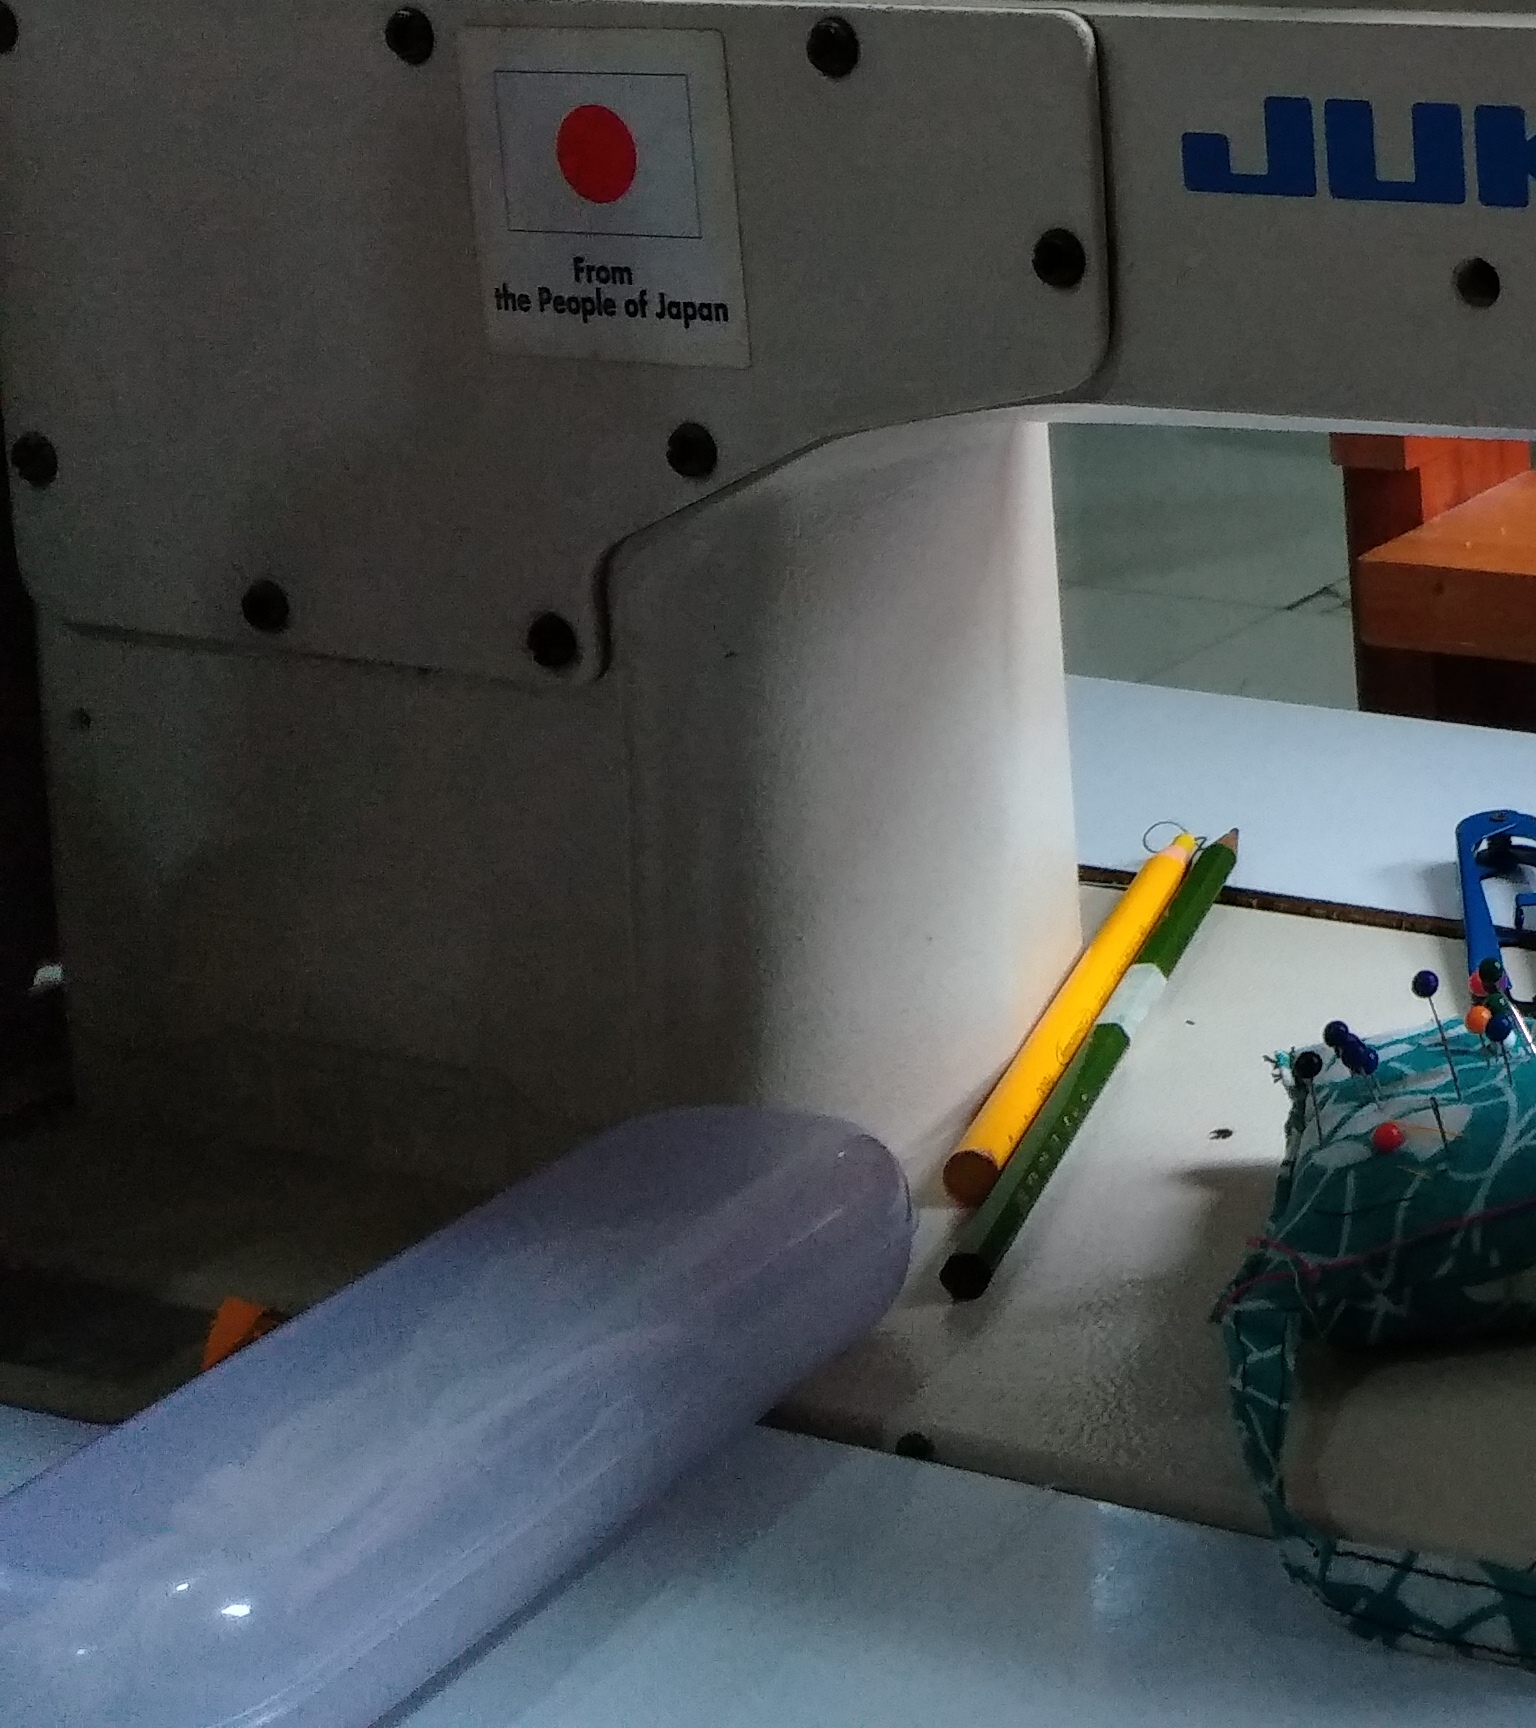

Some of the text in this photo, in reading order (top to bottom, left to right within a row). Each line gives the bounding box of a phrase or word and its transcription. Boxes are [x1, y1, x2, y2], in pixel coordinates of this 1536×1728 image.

[573, 256, 633, 285] From
[494, 283, 730, 330] the People of Japan
